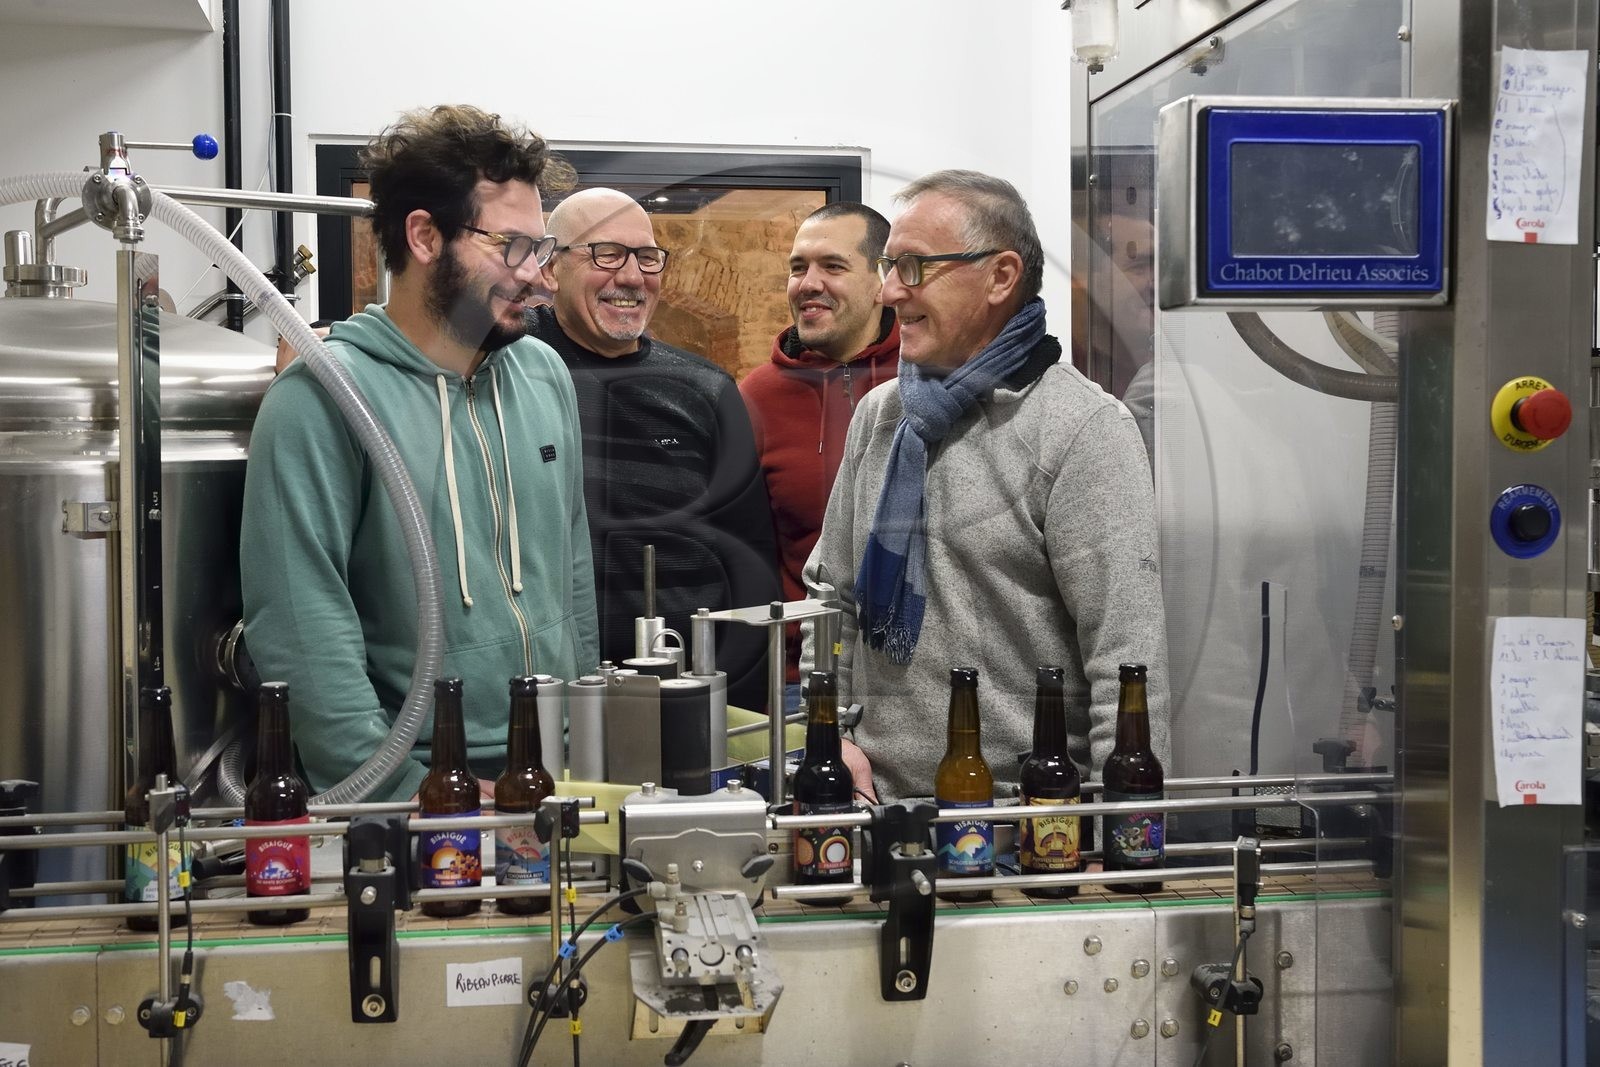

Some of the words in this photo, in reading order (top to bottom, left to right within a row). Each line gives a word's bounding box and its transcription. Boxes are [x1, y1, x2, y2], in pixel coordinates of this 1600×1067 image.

[1515, 217, 1545, 230] Carola
[1220, 263, 1284, 281] Chabot
[1289, 262, 1352, 281] Delrieu
[1356, 262, 1429, 281] Associés
[1515, 779, 1546, 793] Carola
[430, 832, 467, 845] BISAIGUE
